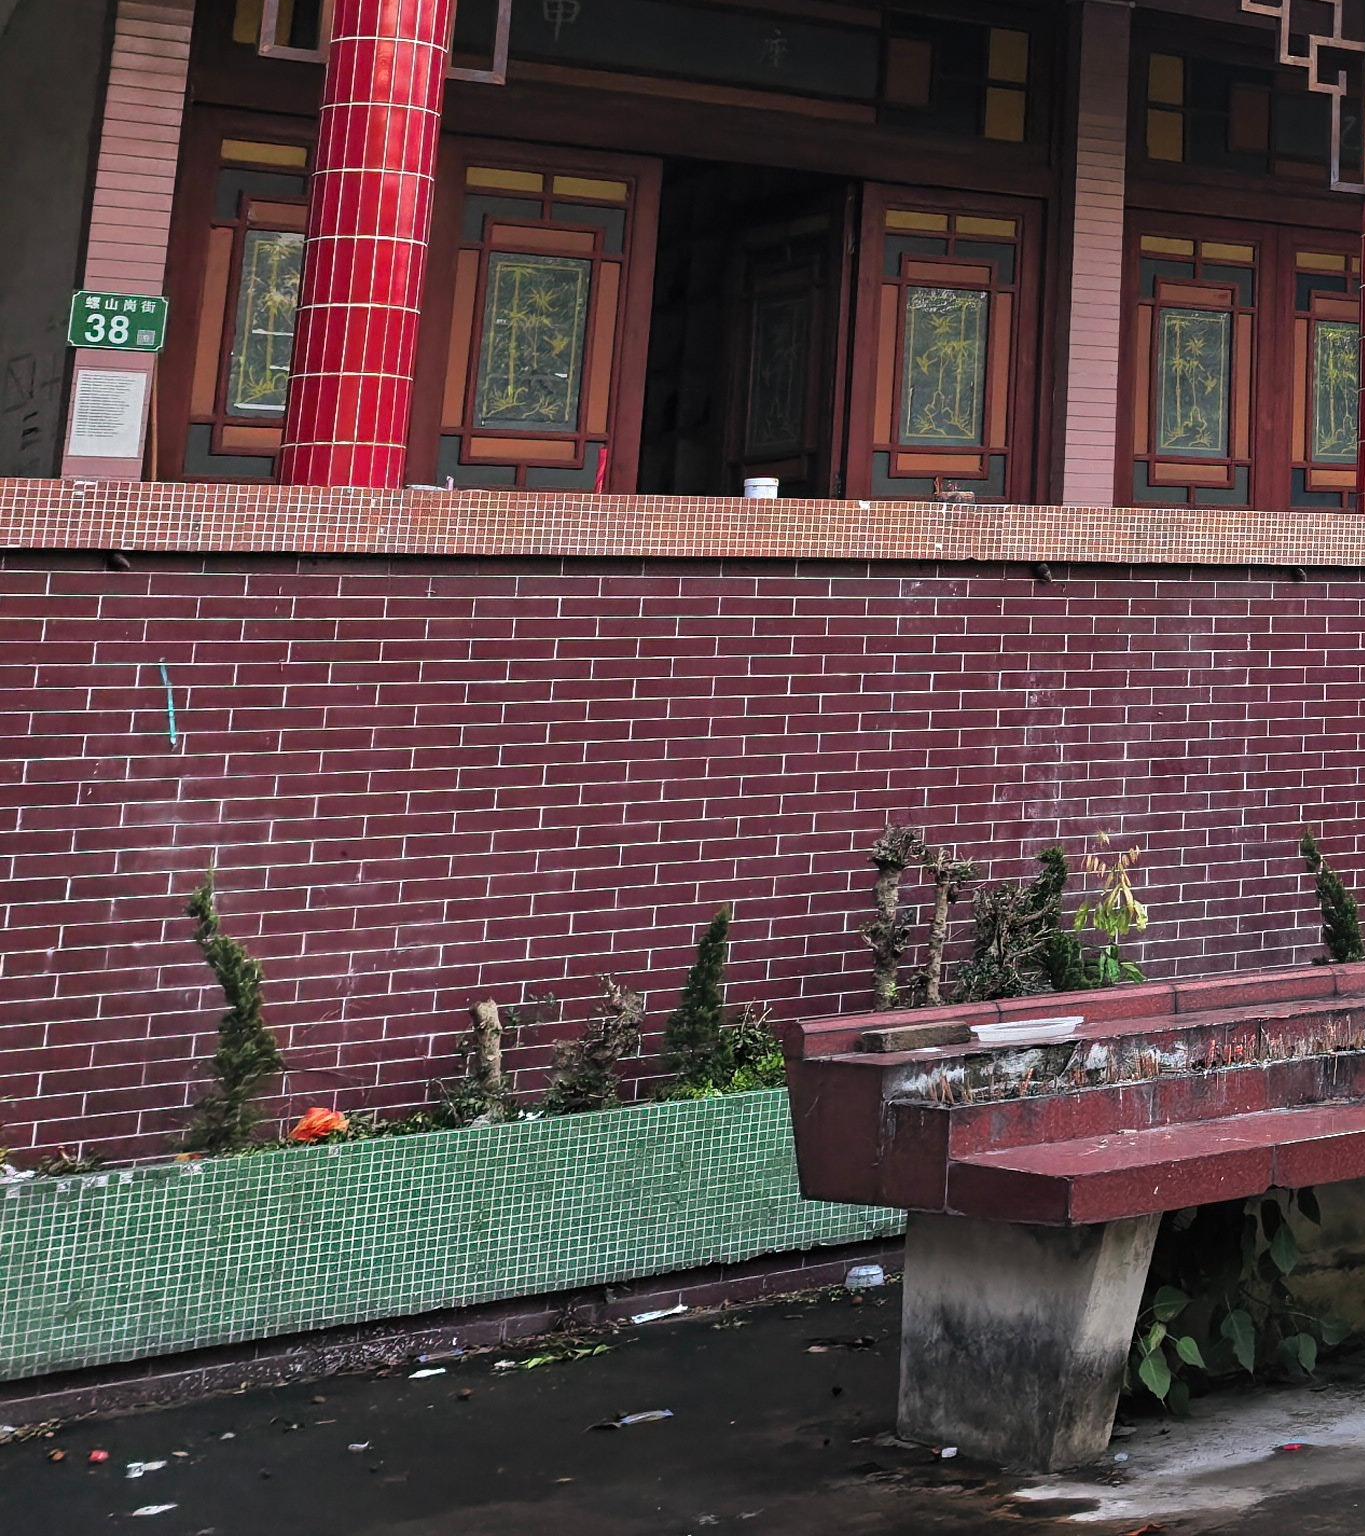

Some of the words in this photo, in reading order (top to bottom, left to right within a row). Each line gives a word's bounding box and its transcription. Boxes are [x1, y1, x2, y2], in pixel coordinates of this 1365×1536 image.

[84, 295, 157, 314] 螺山岗街
[84, 313, 129, 344] 38
